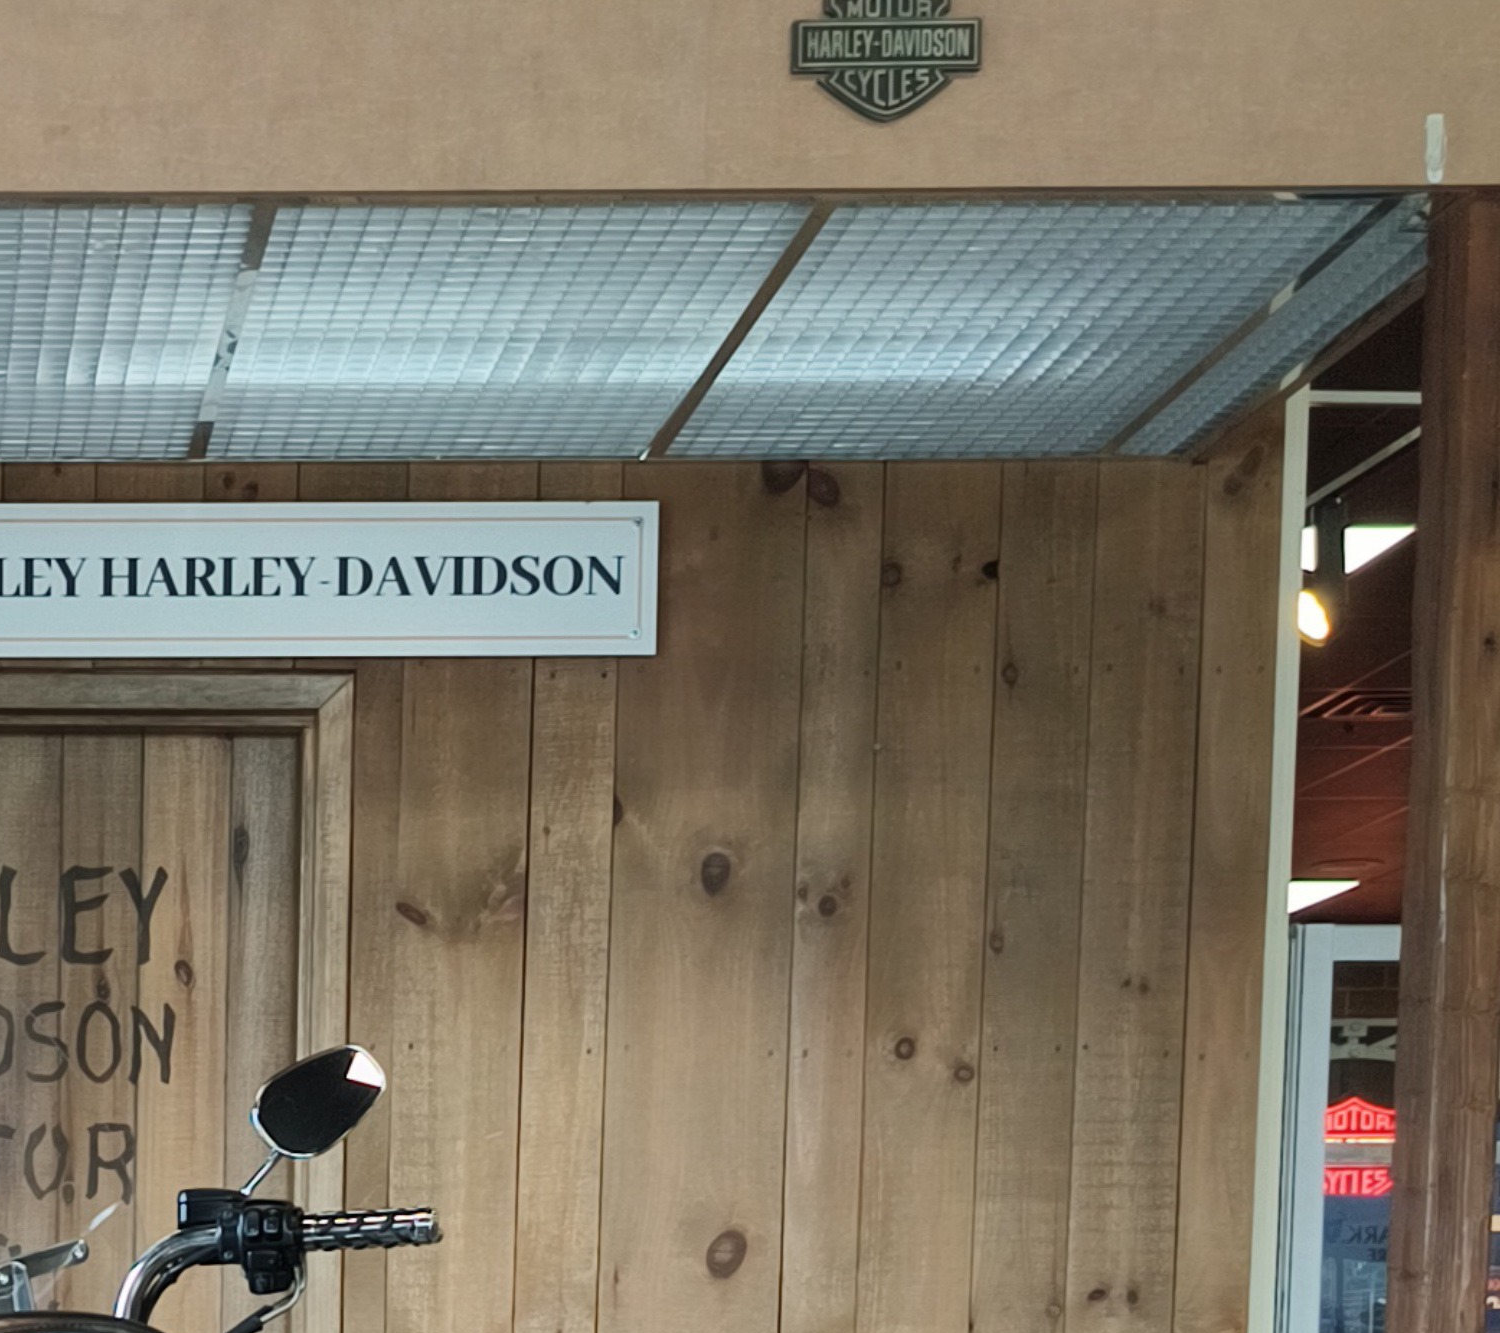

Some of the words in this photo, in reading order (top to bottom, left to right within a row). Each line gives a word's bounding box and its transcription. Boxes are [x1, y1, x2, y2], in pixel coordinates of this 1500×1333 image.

[847, 0, 932, 17] MOTOR
[806, 28, 971, 58] HARLEY-DAVIDSON
[844, 68, 930, 107] CYCLES
[99, 555, 627, 598] HARLEY-DAVIDSON
